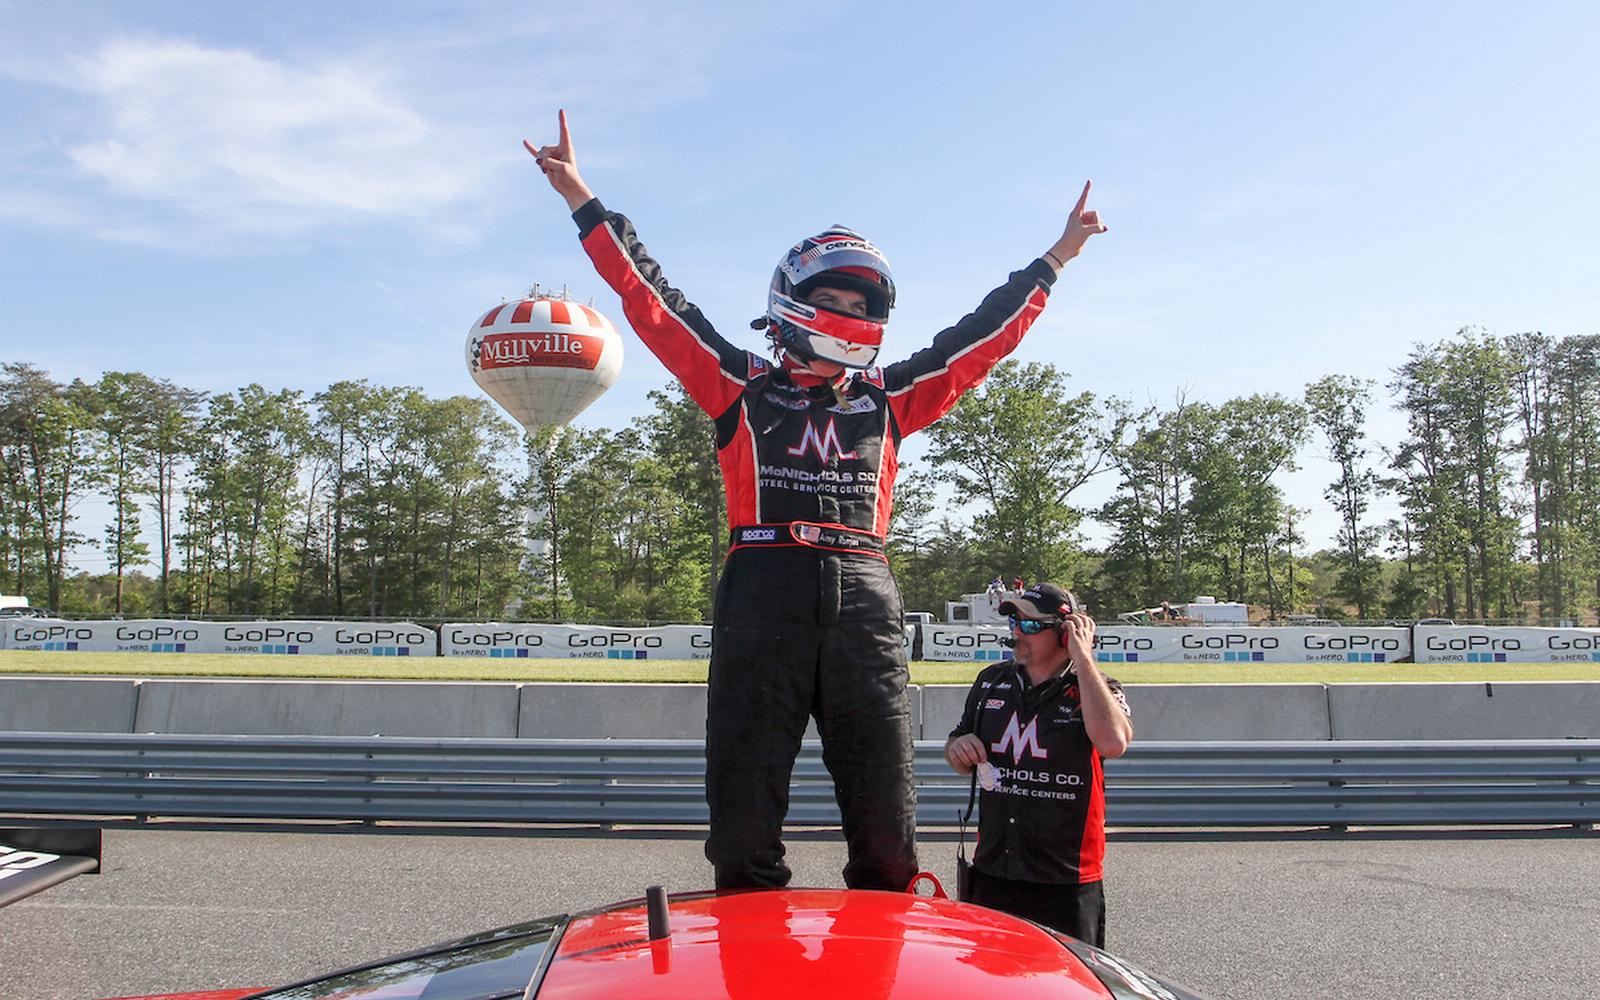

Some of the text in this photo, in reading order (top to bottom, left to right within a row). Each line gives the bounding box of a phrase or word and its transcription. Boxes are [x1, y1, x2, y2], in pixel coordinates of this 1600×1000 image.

[484, 334, 583, 361] Millville
[793, 482, 838, 494] SERVICE
[742, 529, 775, 540] sparco
[15, 626, 93, 641] GoPro
[116, 627, 199, 641] GoPro
[224, 627, 314, 643] GoPro
[336, 629, 425, 645] GoPro
[452, 630, 543, 647] GoPro
[568, 632, 663, 648] GoPro
[1092, 635, 1153, 651] Pro
[1182, 634, 1279, 650] GoPro
[1304, 635, 1400, 651] GoPro
[1427, 635, 1521, 651] GoPro
[998, 767, 1084, 786] CHOLS CO.
[1031, 789, 1076, 801] CENTERS
